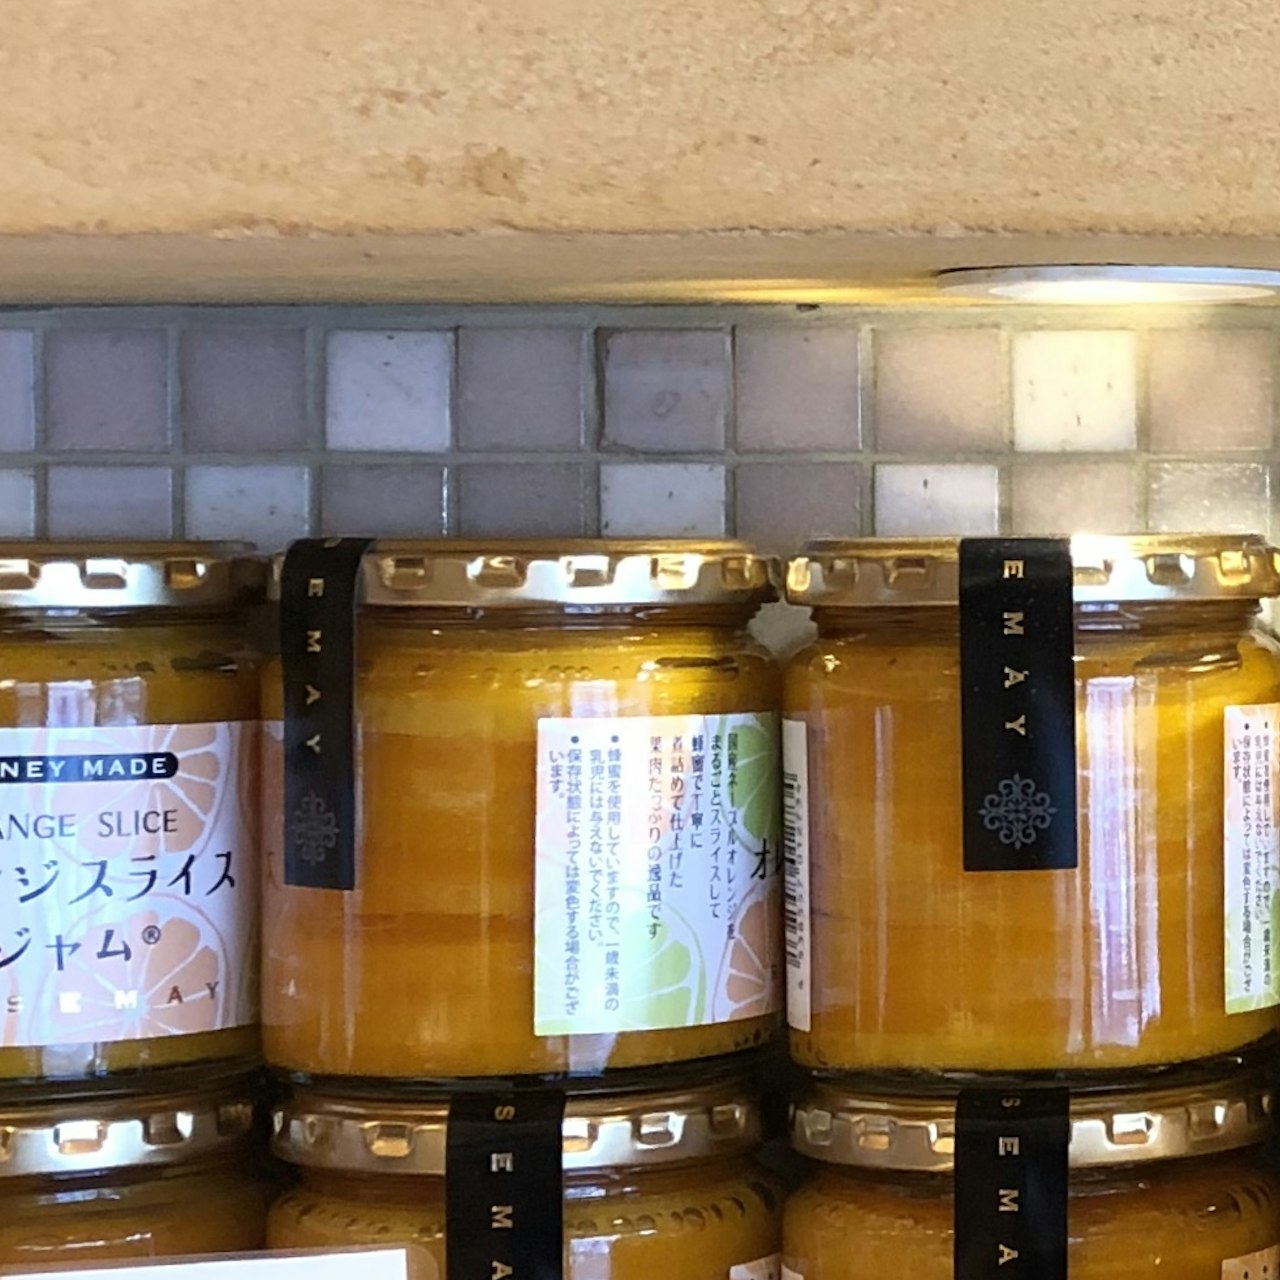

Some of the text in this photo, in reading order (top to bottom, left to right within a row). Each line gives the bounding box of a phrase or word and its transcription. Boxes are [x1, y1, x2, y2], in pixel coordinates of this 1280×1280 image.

[0, 757, 168, 779] NEY MADE
[97, 809, 178, 838] SLICE
[709, 734, 723, 920] まるごとスライスして
